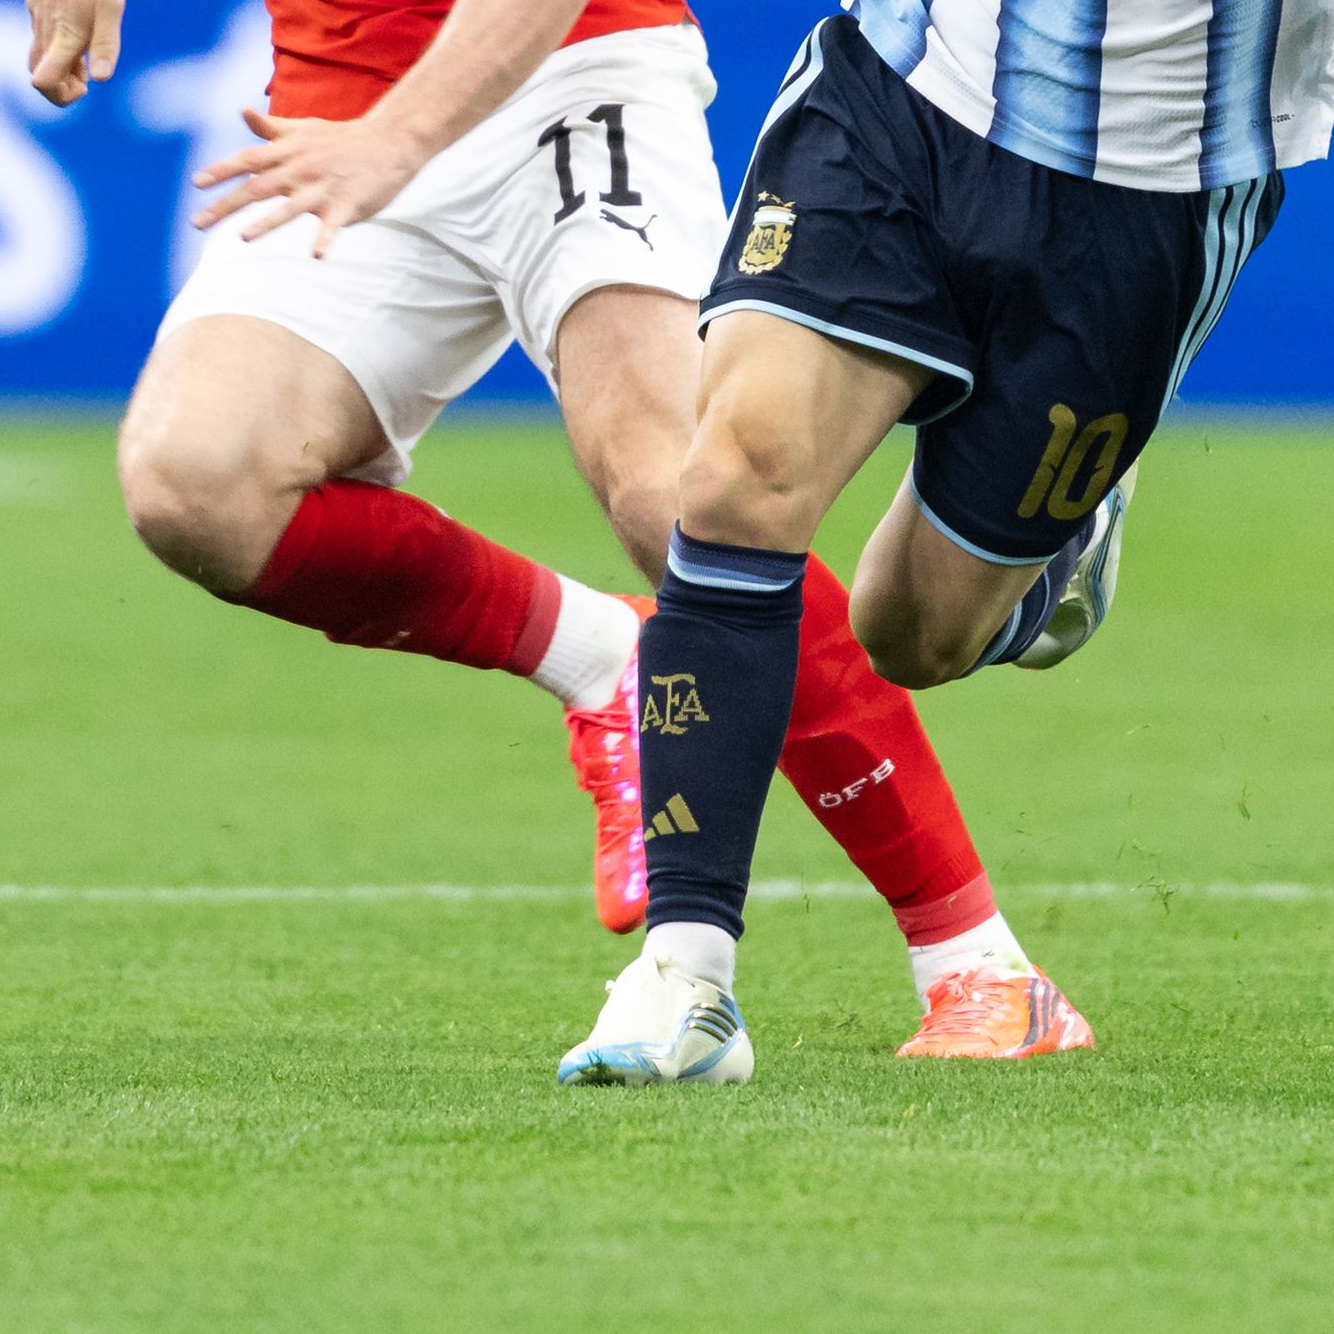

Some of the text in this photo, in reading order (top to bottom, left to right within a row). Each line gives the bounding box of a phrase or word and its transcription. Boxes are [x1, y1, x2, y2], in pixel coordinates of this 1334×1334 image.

[537, 104, 642, 226] 11
[1017, 403, 1128, 520] 10
[640, 673, 710, 735] AFA
[818, 758, 896, 808] ÖFB
